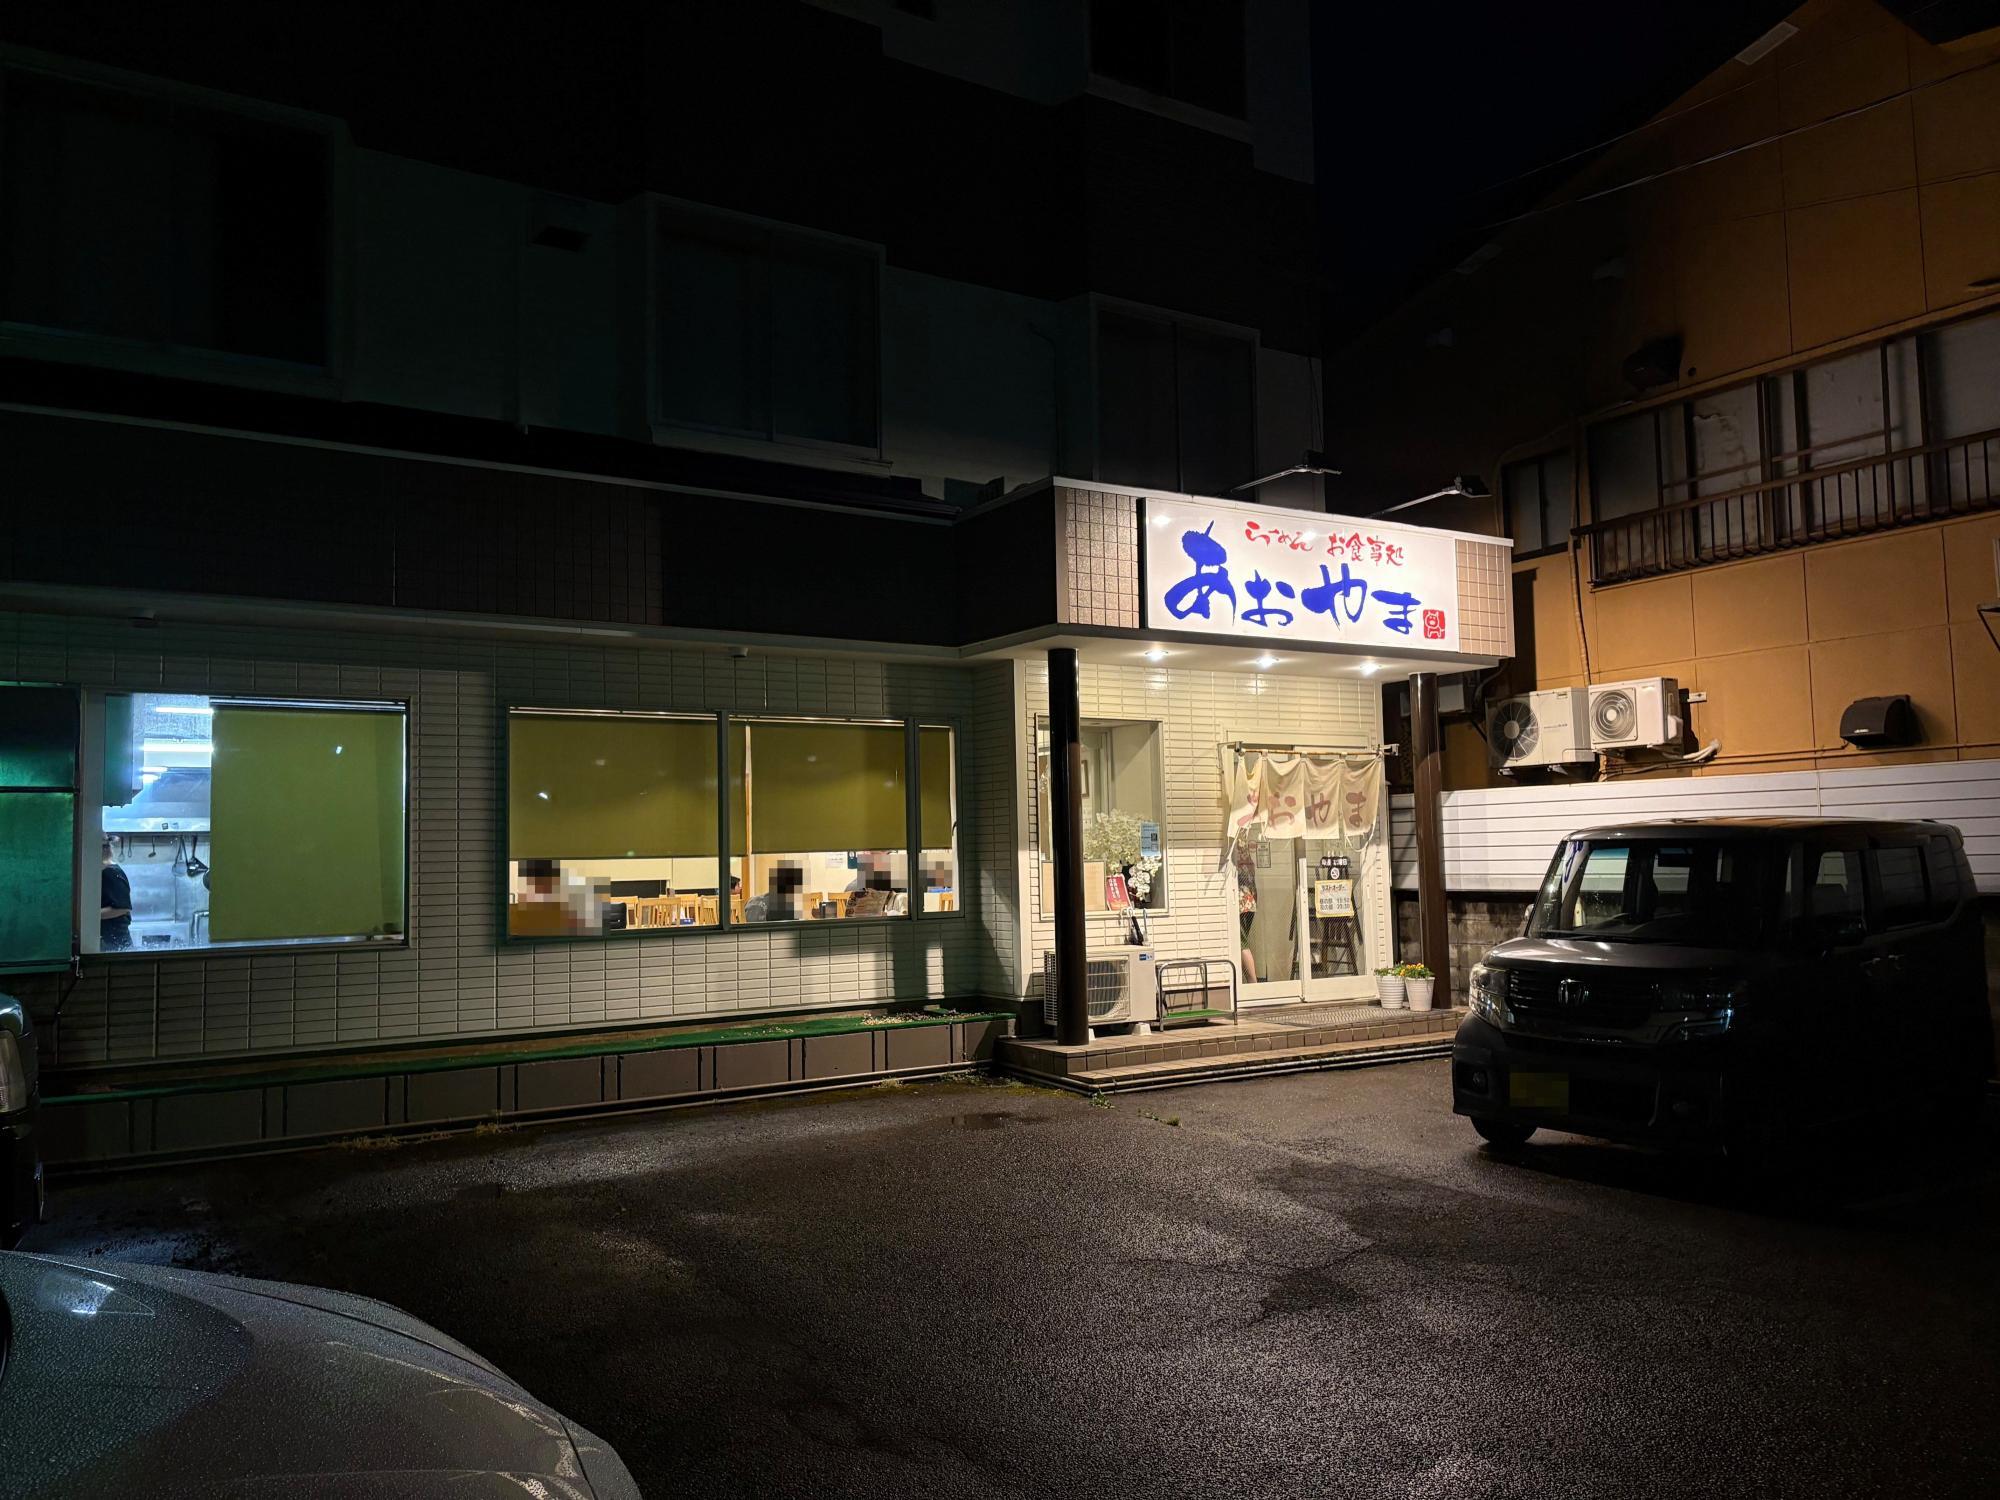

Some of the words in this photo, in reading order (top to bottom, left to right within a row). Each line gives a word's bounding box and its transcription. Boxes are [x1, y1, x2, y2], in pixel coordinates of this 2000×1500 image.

[1164, 520, 1421, 635] あおやま
[1326, 532, 1405, 567] お食事処
